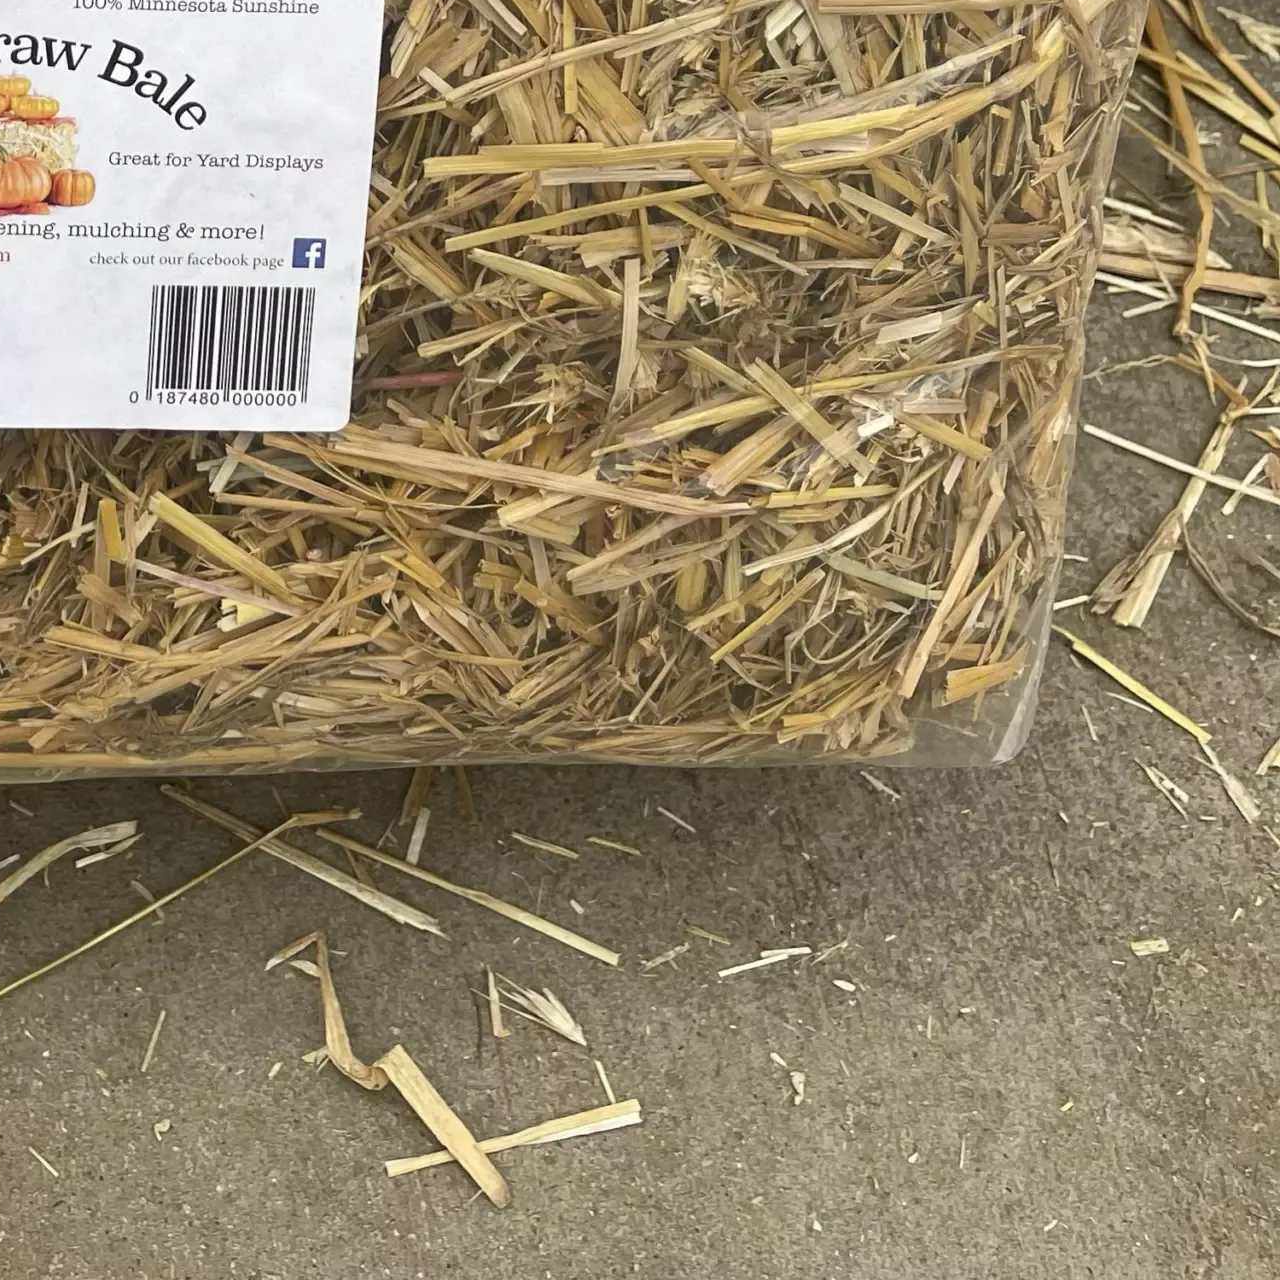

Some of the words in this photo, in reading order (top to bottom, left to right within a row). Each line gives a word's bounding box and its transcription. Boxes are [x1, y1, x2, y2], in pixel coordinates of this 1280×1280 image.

[97, 39, 208, 131] Bale
[108, 151, 161, 167] Great
[165, 152, 192, 167] for
[196, 153, 240, 169] Yard
[245, 154, 324, 172] Displays
[68, 222, 171, 242] mulching
[176, 223, 195, 239] &
[200, 223, 265, 240] more!
[89, 252, 129, 266] check
[132, 254, 155, 266] out
[159, 254, 184, 266] our
[187, 252, 249, 267] facebook
[253, 255, 285, 270] page
[128, 391, 139, 404] 0
[156, 392, 220, 406] 187480
[232, 393, 297, 407] 000000
